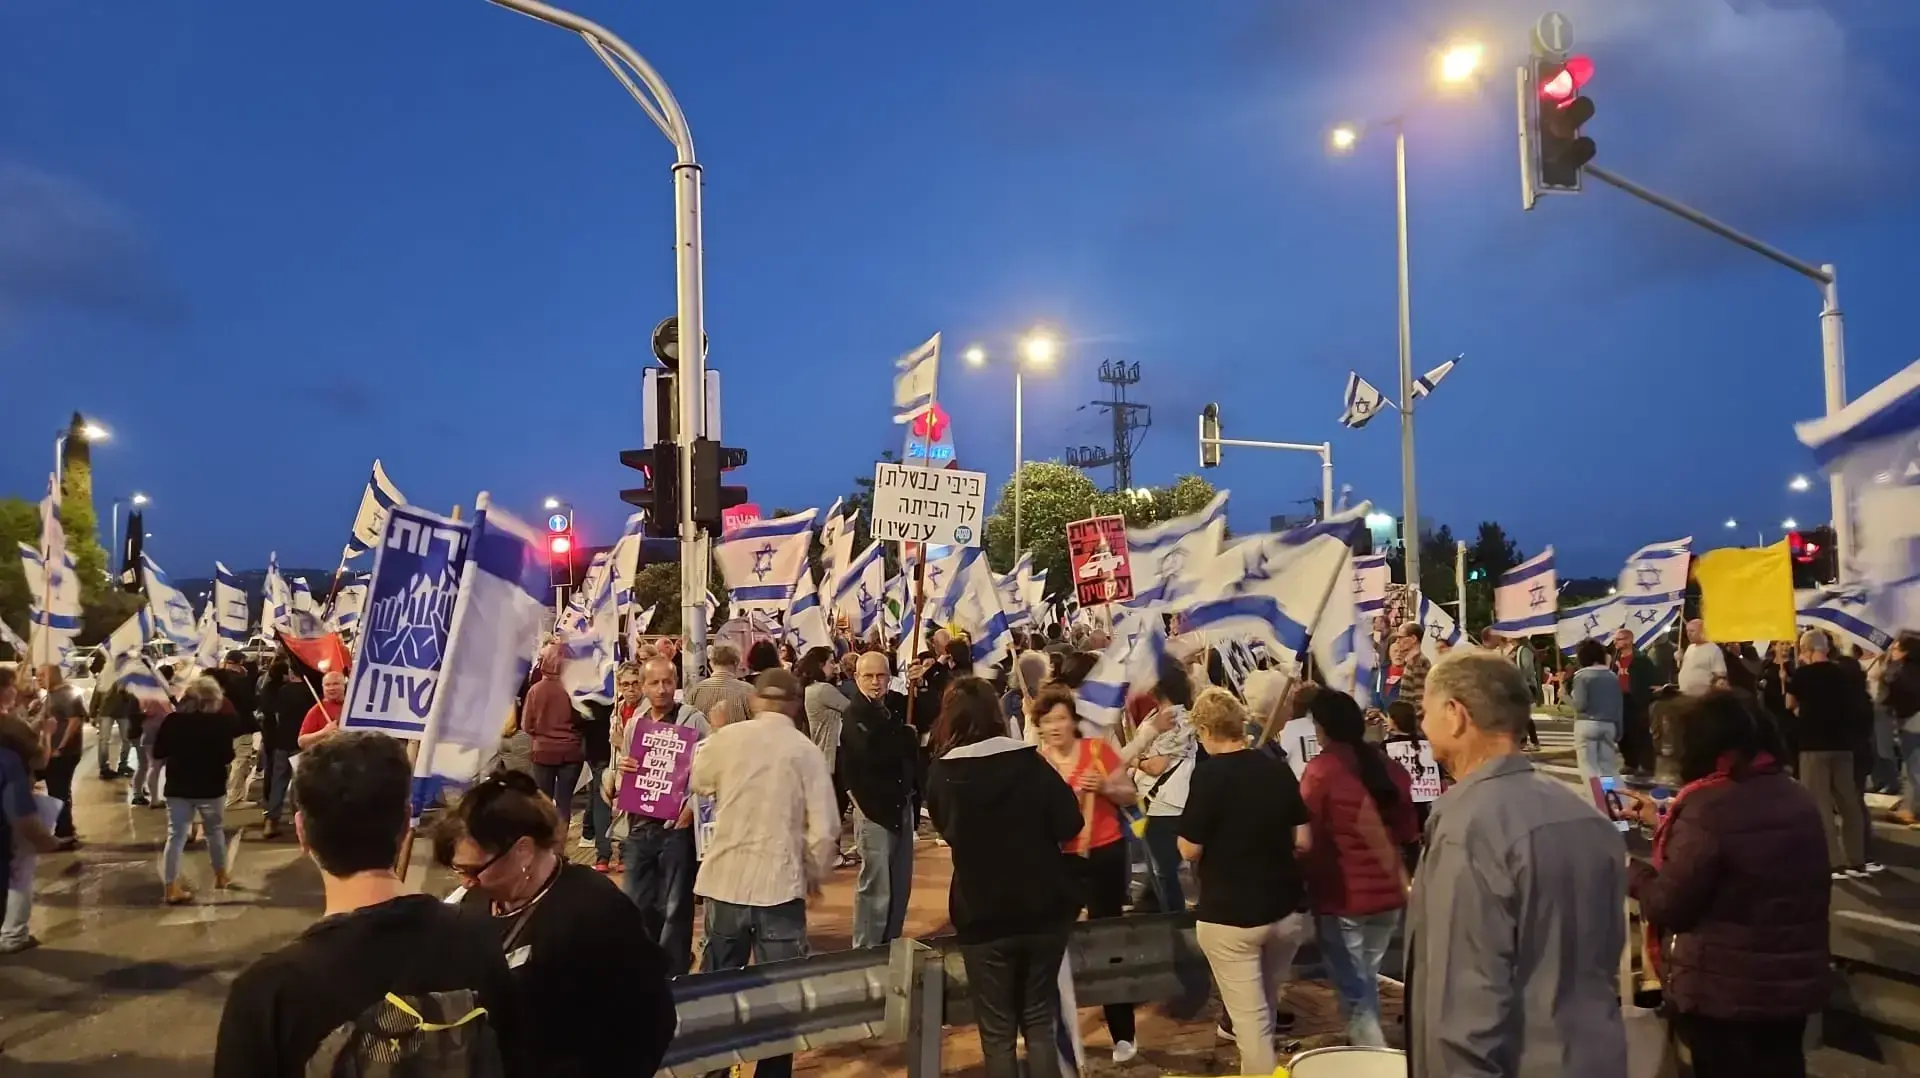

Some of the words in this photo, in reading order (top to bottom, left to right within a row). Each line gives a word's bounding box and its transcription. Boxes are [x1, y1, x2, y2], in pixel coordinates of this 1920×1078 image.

[878, 465, 940, 491] נכשלת!
[947, 475, 980, 497] ביבי
[898, 497, 950, 519] הביתה
[957, 500, 976, 524] לך
[644, 736, 685, 752] הפסקת
[650, 758, 668, 769] אש
[639, 777, 669, 791] עכשיו
